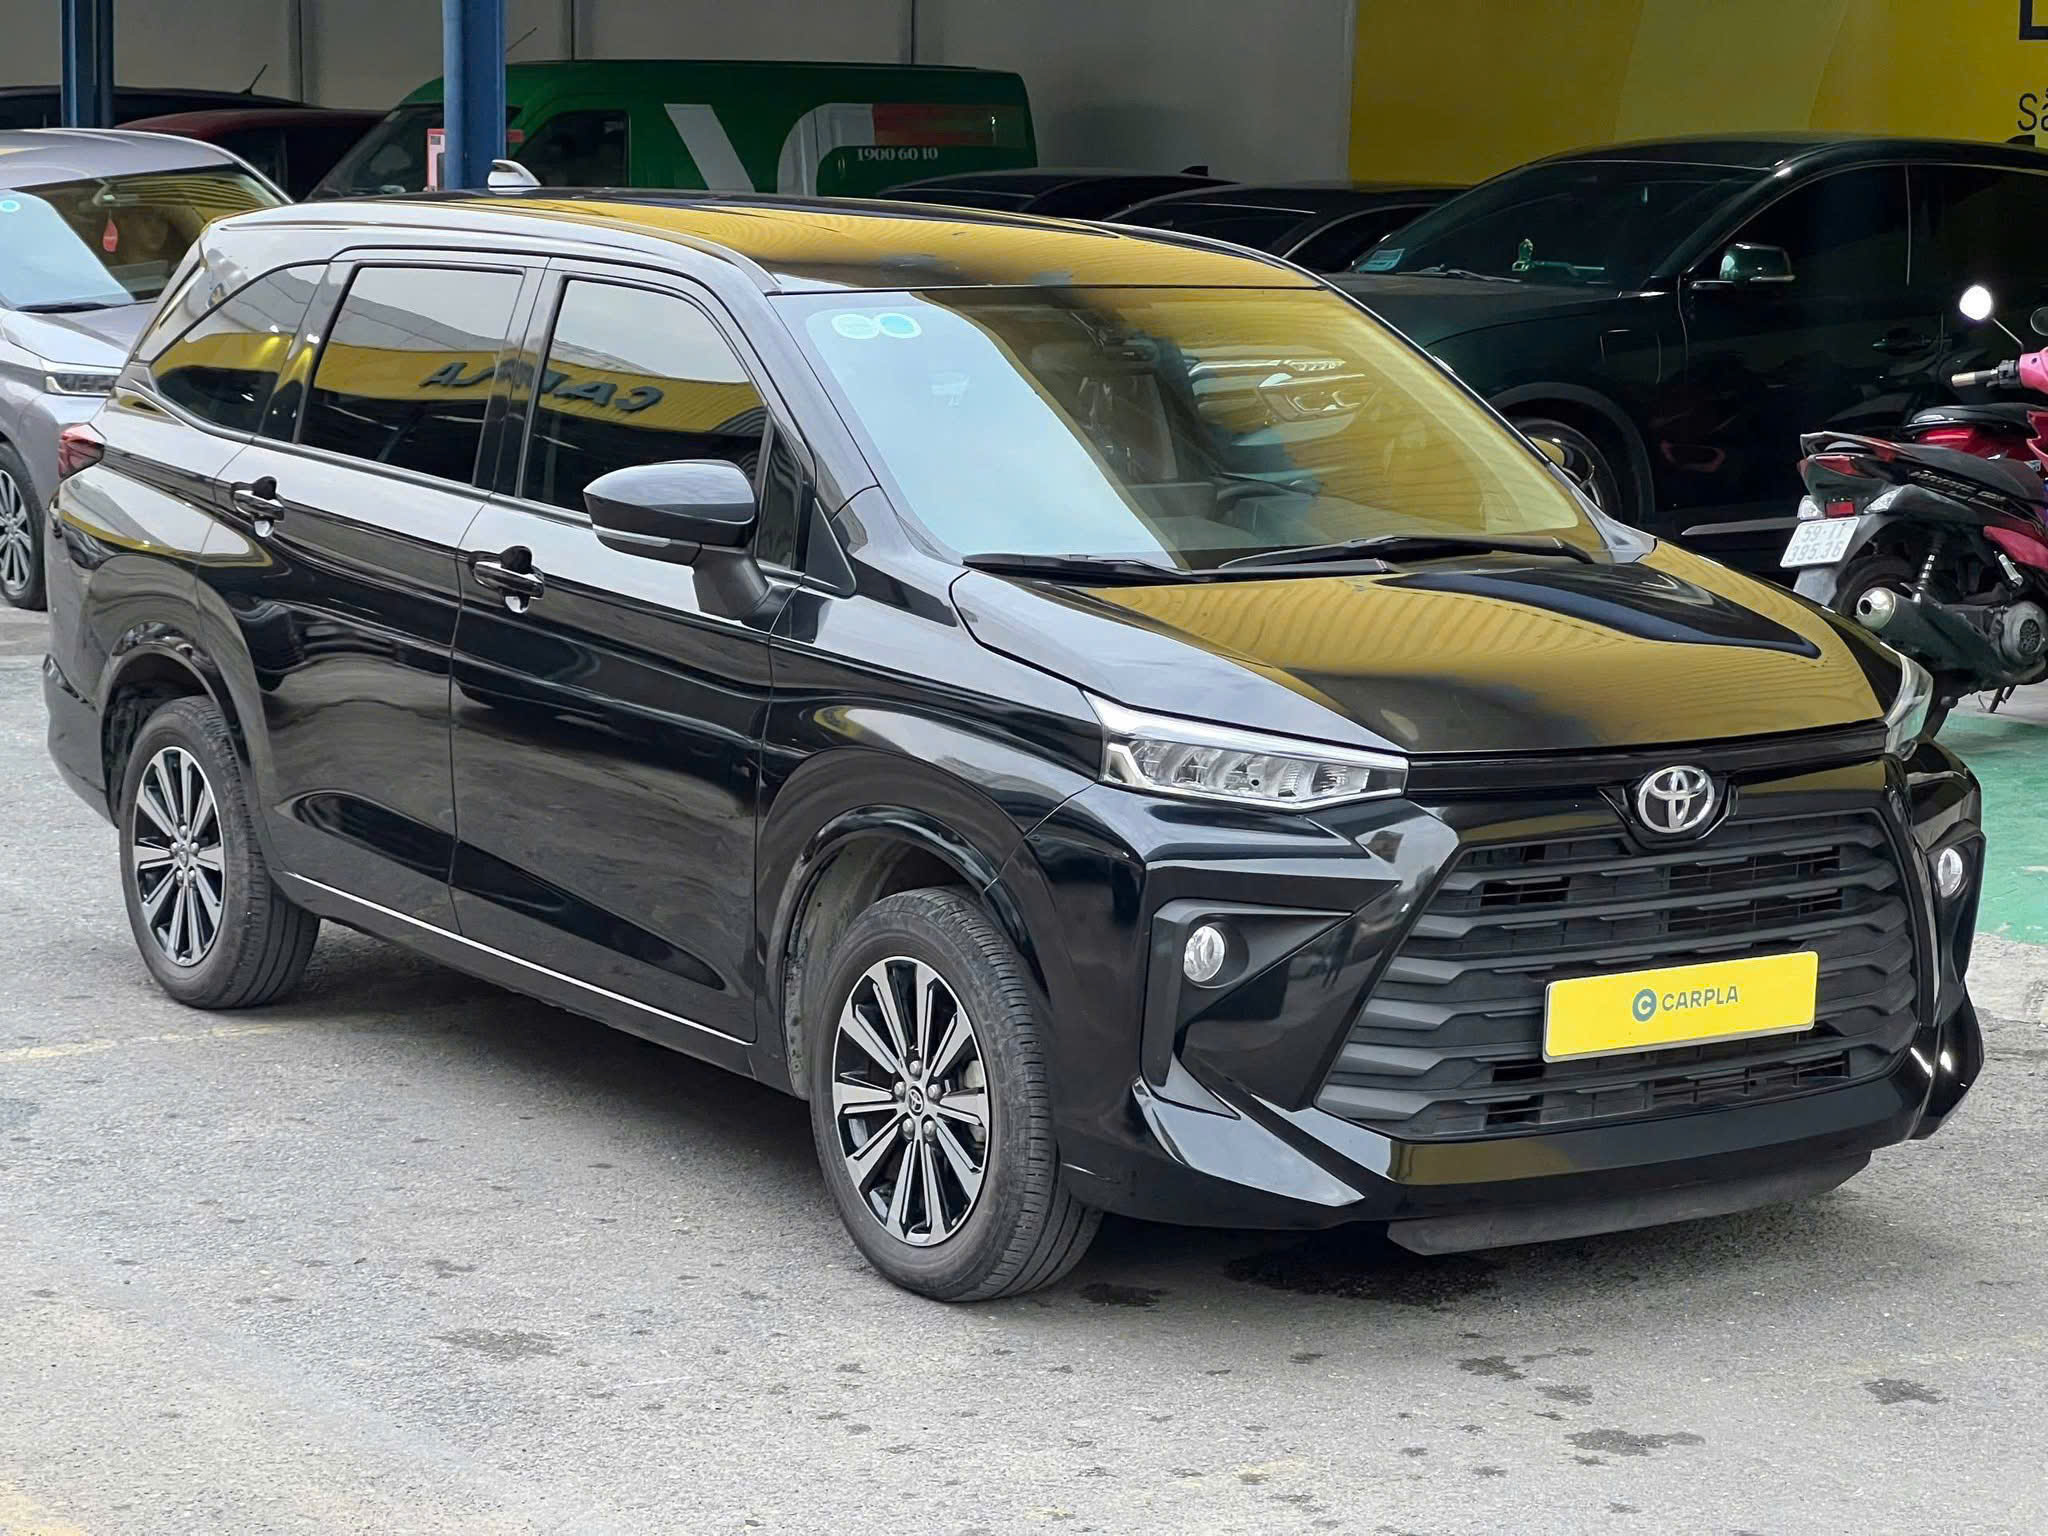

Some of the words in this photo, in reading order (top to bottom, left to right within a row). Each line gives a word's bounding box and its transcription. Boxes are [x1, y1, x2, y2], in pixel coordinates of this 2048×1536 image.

[857, 146, 895, 161] 1900
[897, 146, 919, 161] 60
[922, 146, 939, 161] 10
[1661, 985, 1739, 1012] CARPLA
